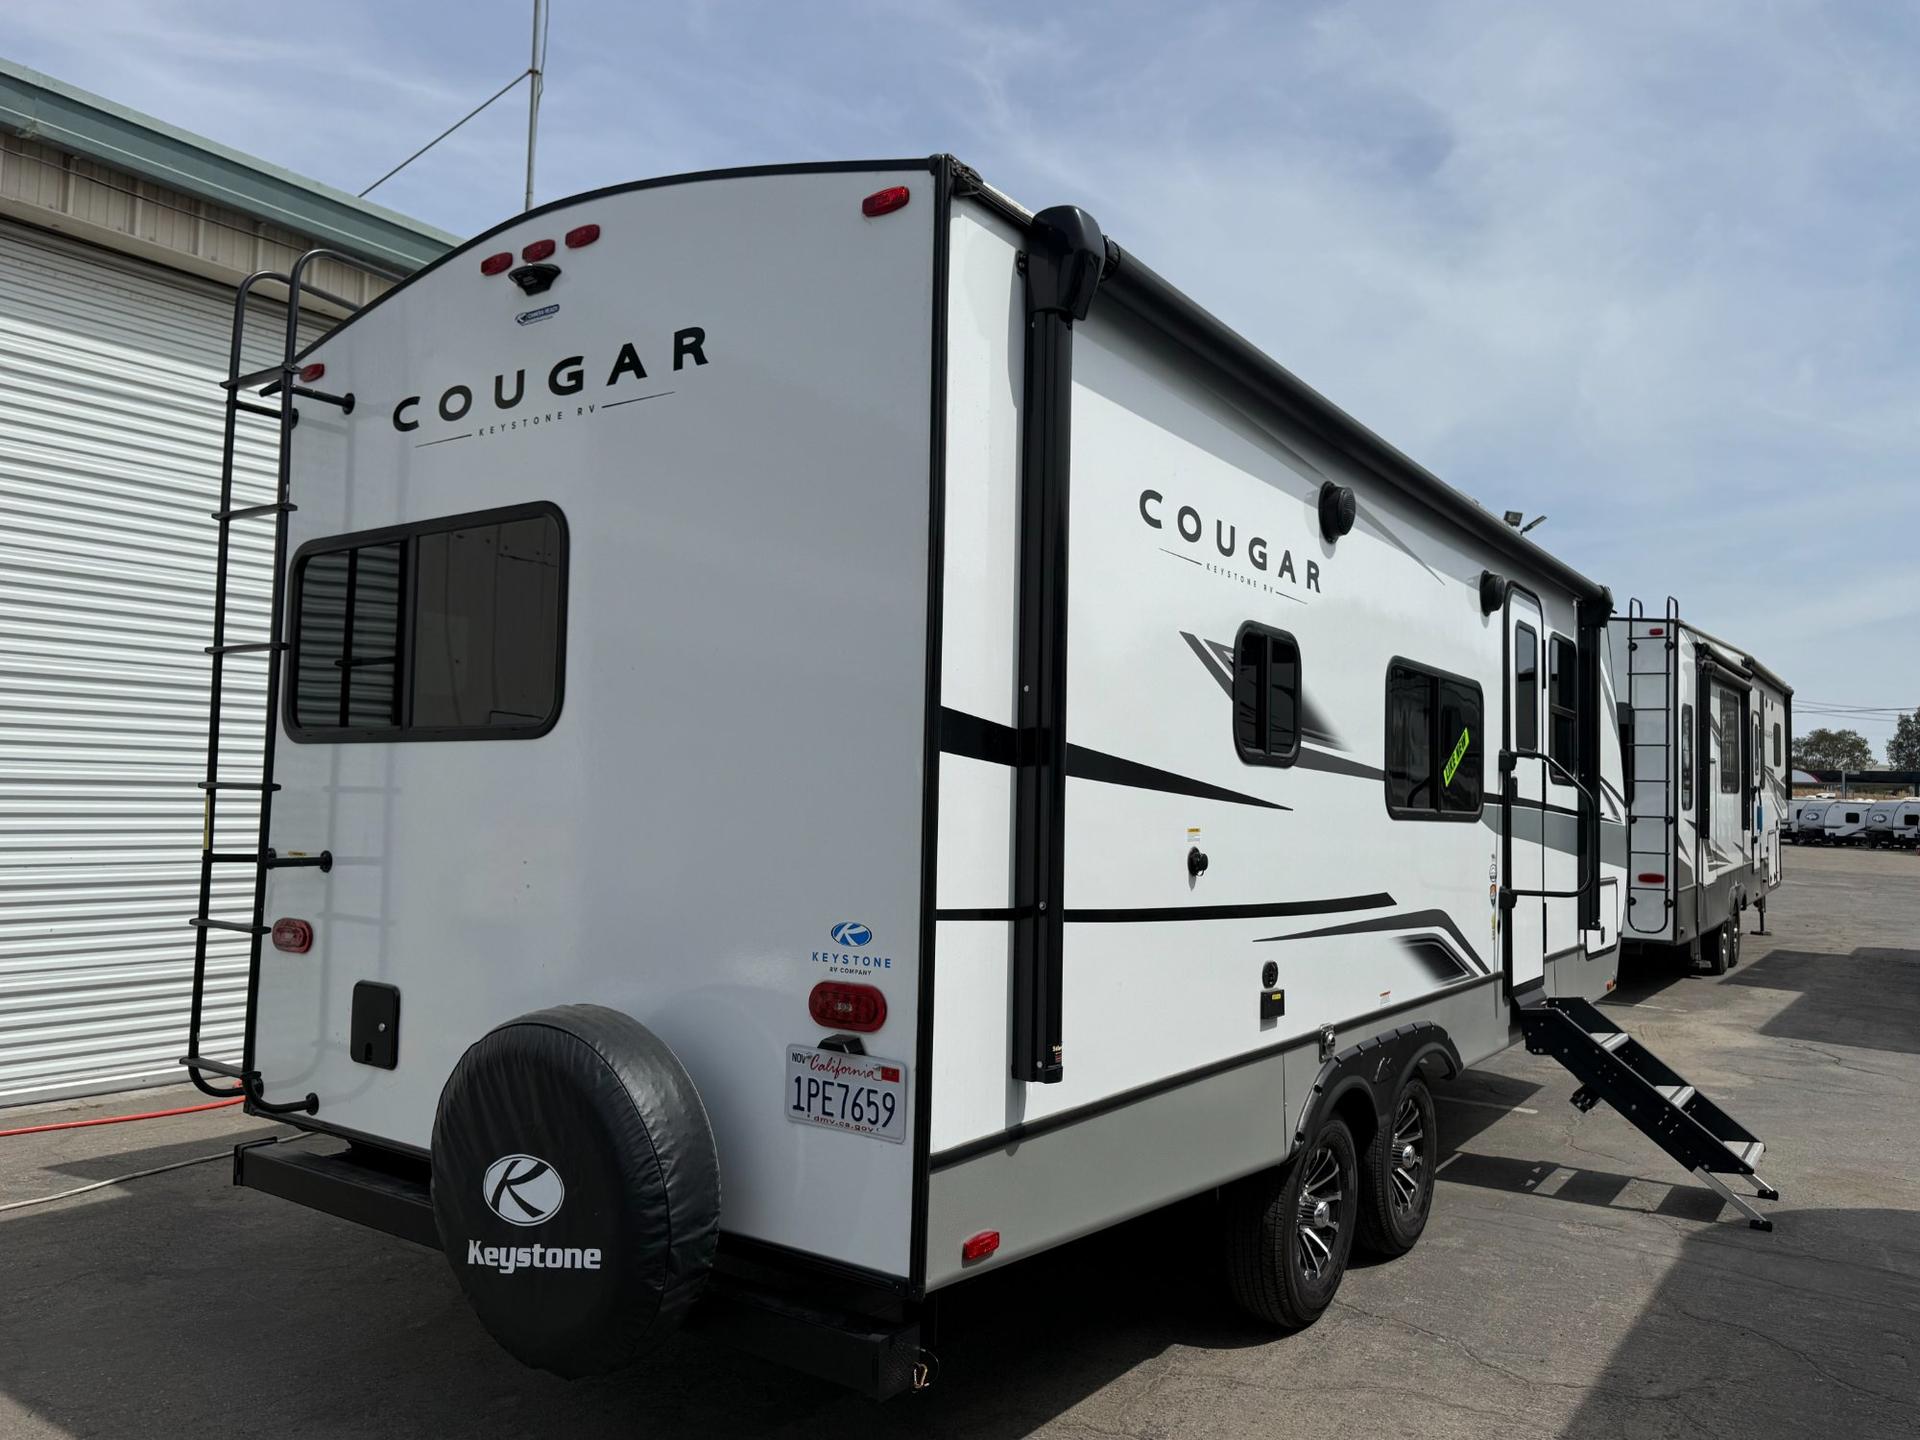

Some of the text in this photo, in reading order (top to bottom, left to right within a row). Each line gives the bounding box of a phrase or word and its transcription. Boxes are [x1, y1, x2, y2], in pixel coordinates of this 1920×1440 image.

[393, 327, 709, 432] COUGAR
[478, 404, 595, 437] KEYSTONE RV
[1138, 489, 1321, 593] COUGAR
[1206, 563, 1257, 588] KEYSTONE
[812, 951, 891, 969] KEYSTONE
[840, 967, 872, 976] COMPANY
[792, 1052, 877, 1080] NOV California
[792, 1075, 896, 1128] 1PE7659
[813, 1115, 874, 1133] dmv.ca.gov
[467, 1239, 602, 1274] Keystone
